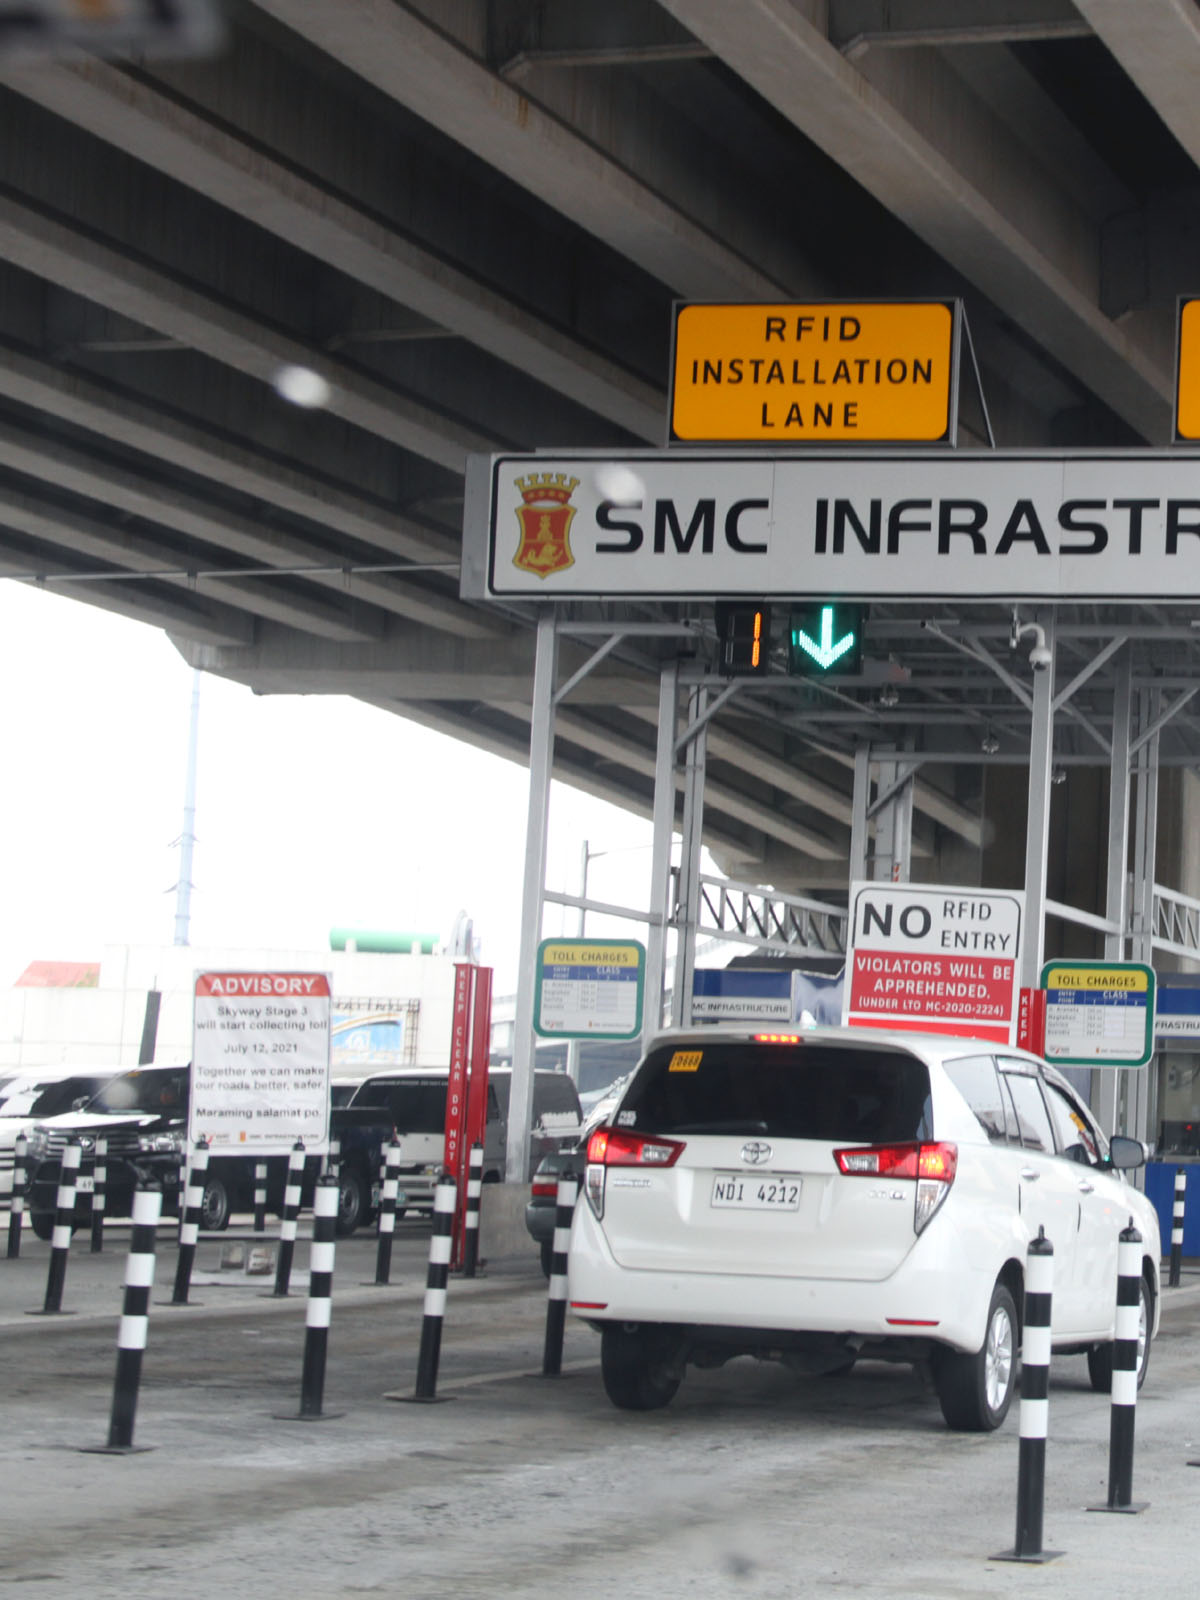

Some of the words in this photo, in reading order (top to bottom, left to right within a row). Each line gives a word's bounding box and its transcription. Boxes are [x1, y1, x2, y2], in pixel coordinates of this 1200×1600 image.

[765, 316, 862, 342] RFID
[692, 358, 932, 385] INSTALLATION
[761, 402, 858, 428] LANE
[595, 498, 770, 554] SMC
[750, 611, 762, 668] 1
[862, 902, 932, 939] NO
[943, 900, 992, 921] RFID
[940, 930, 1011, 951] ENTRY
[552, 951, 576, 961] TOLL
[581, 952, 628, 963] CHARGES
[596, 966, 620, 974] CLASS
[857, 957, 942, 976] VIOLATORS
[949, 963, 985, 979] WILL
[993, 966, 1011, 981] BE
[210, 978, 315, 993] ADVISORY
[458, 969, 466, 1013] KEEP
[873, 978, 991, 999] APPREHENDED.
[1057, 975, 1082, 985] TOLL
[1087, 976, 1136, 987] CHARGES
[1103, 991, 1128, 999] CLASS
[218, 1006, 262, 1017] Skyway
[265, 1006, 297, 1017] Stage
[301, 1006, 308, 1015] 3
[708, 1003, 789, 1013] INFRASTRUCTURE
[859, 996, 898, 1009] (UNDER
[903, 1000, 921, 1010] LTO
[926, 1002, 1004, 1016] MC-2020-2224)
[197, 1020, 216, 1030] will
[220, 1020, 246, 1030] start
[249, 1020, 306, 1032] collecting
[309, 1020, 327, 1030] toll
[1020, 995, 1028, 1040] KEEP
[224, 1043, 248, 1055] July
[252, 1043, 268, 1054] 12,
[272, 1043, 298, 1053] 2021
[454, 1026, 463, 1081] CLEAR
[197, 1067, 246, 1078] Together
[250, 1068, 266, 1076] we
[269, 1068, 290, 1076] can
[294, 1067, 325, 1076] make
[195, 1082, 214, 1090] our
[218, 1080, 250, 1090] roads
[196, 1109, 253, 1119] Maraming
[256, 1108, 301, 1118] salamat
[451, 1094, 459, 1116] DO
[449, 1130, 457, 1161] NOT
[714, 1183, 744, 1202] NDI
[757, 1184, 798, 1204] 4212
